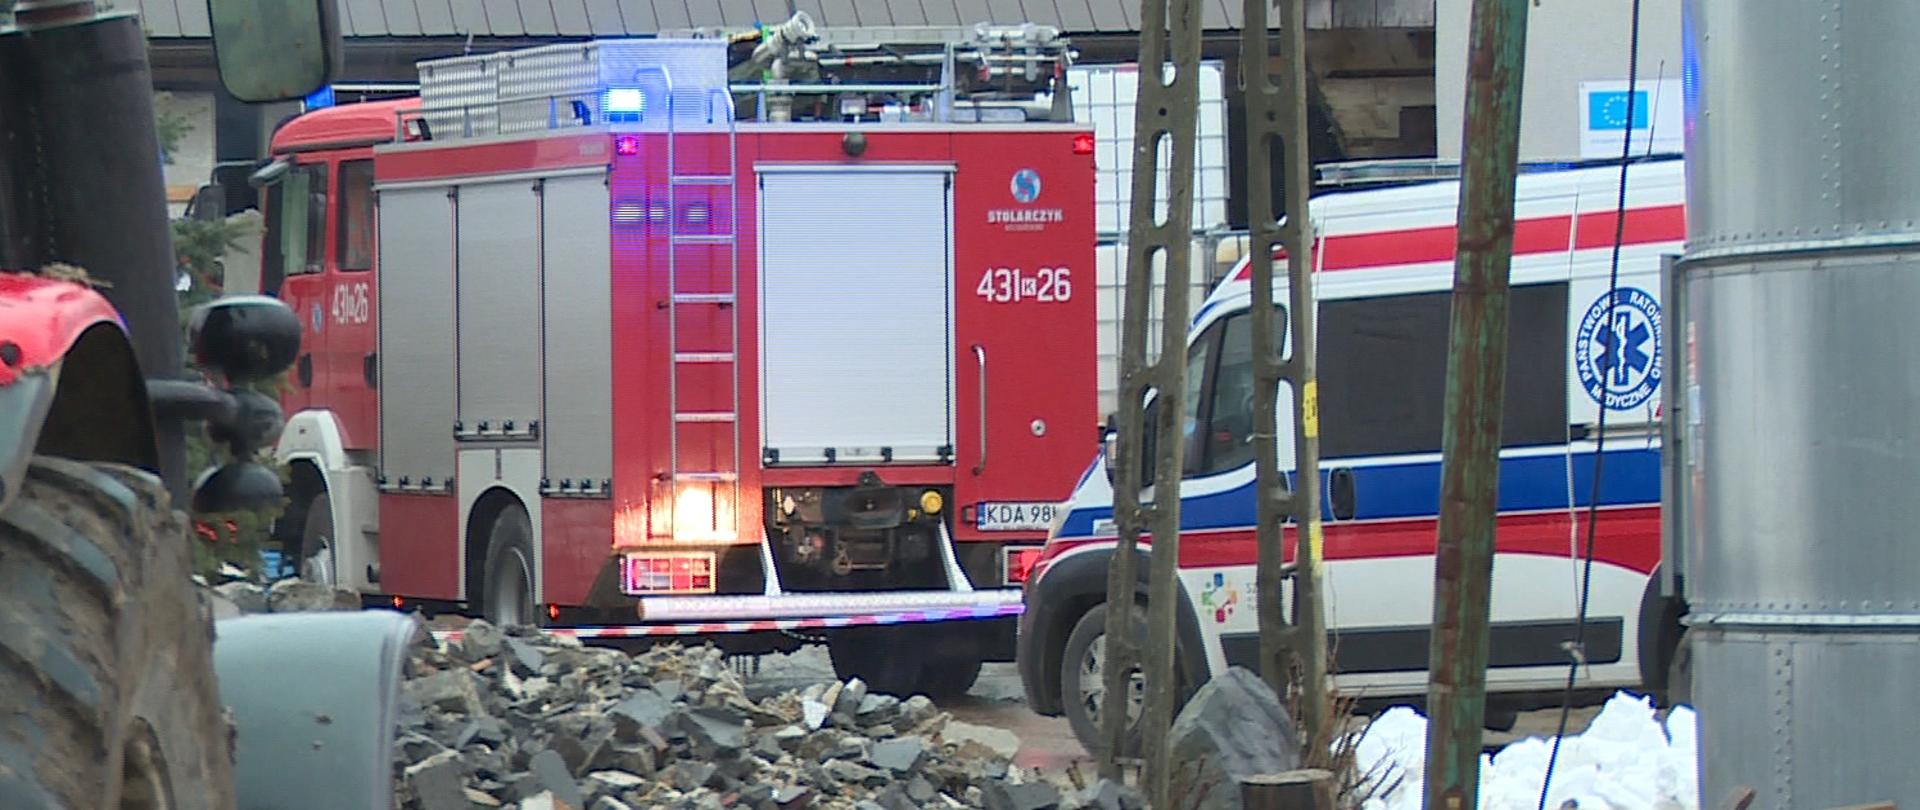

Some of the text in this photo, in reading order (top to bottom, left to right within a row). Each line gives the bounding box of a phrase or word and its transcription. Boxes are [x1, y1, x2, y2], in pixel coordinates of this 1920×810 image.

[987, 209, 1064, 223] STOLARCZYK
[1590, 381, 1652, 408] MDYCZNE
[987, 505, 1025, 524] KDA
